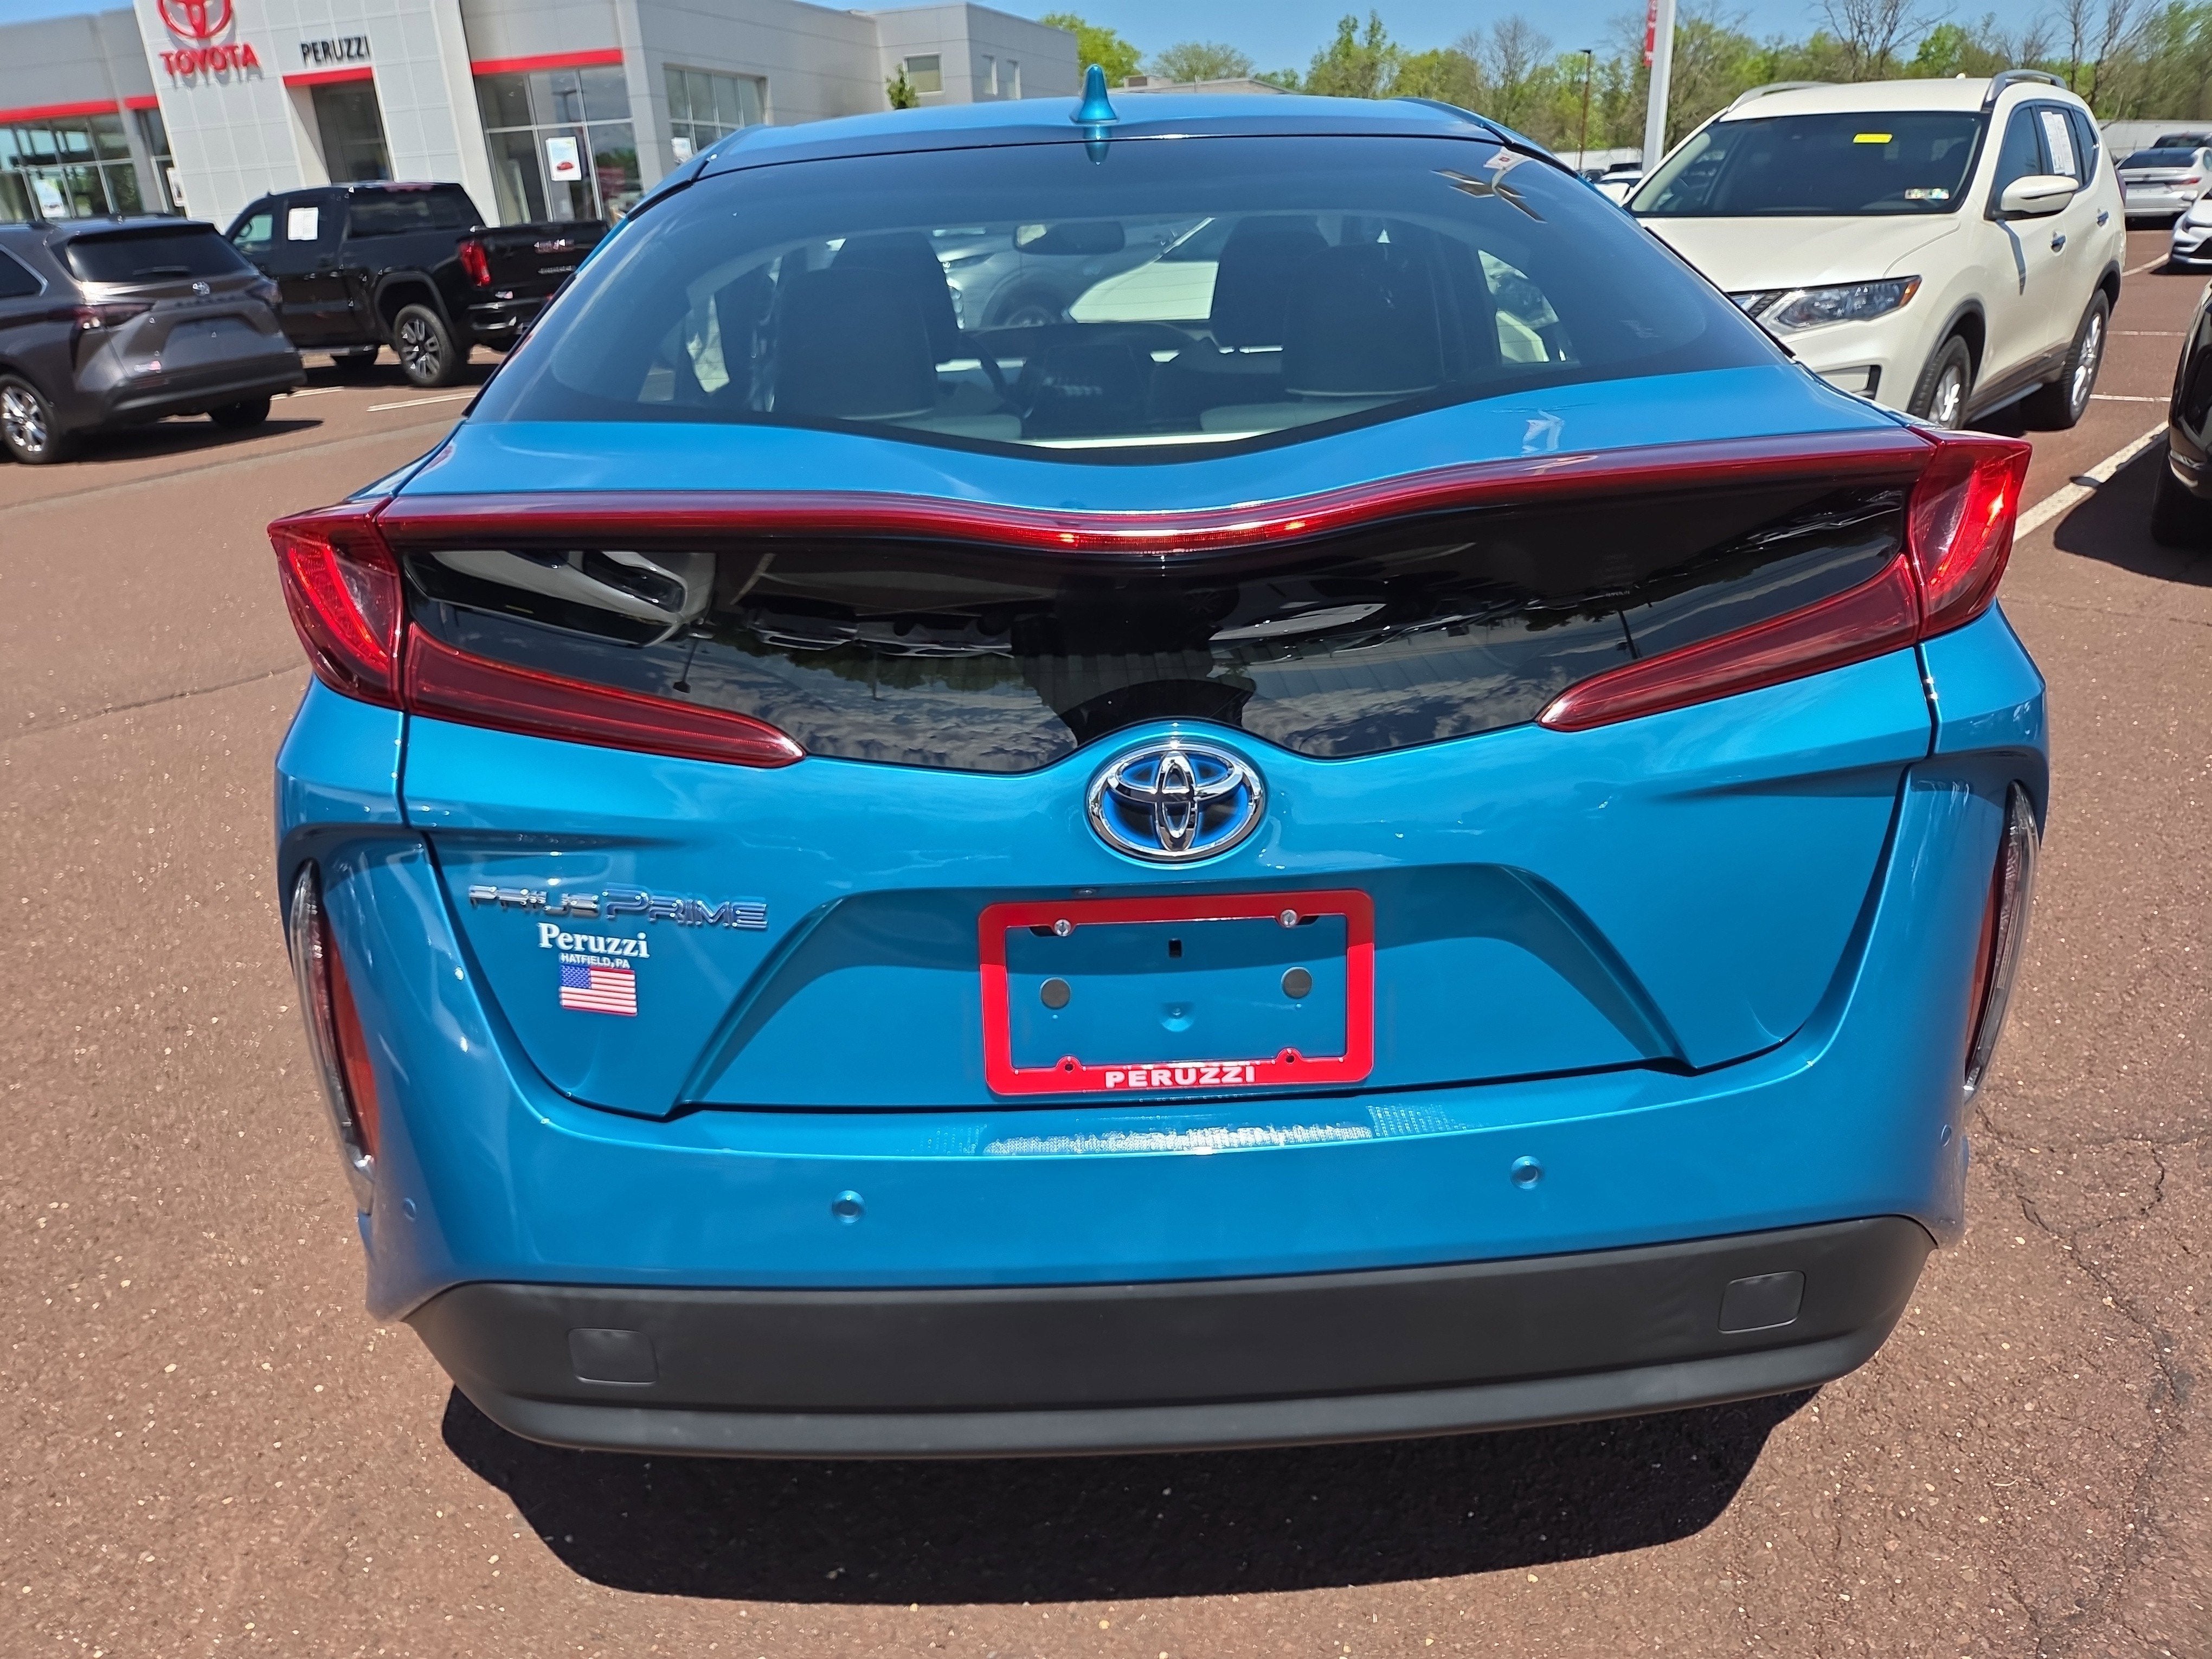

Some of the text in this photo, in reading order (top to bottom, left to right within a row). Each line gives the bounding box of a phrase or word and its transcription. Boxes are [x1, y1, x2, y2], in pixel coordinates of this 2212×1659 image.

[158, 43, 260, 75] TOYOTA
[300, 35, 370, 65] PERUZZI
[602, 883, 768, 930] PRIME
[537, 922, 650, 958] Peruzzi
[1105, 1066, 1255, 1088] PERUZZI
